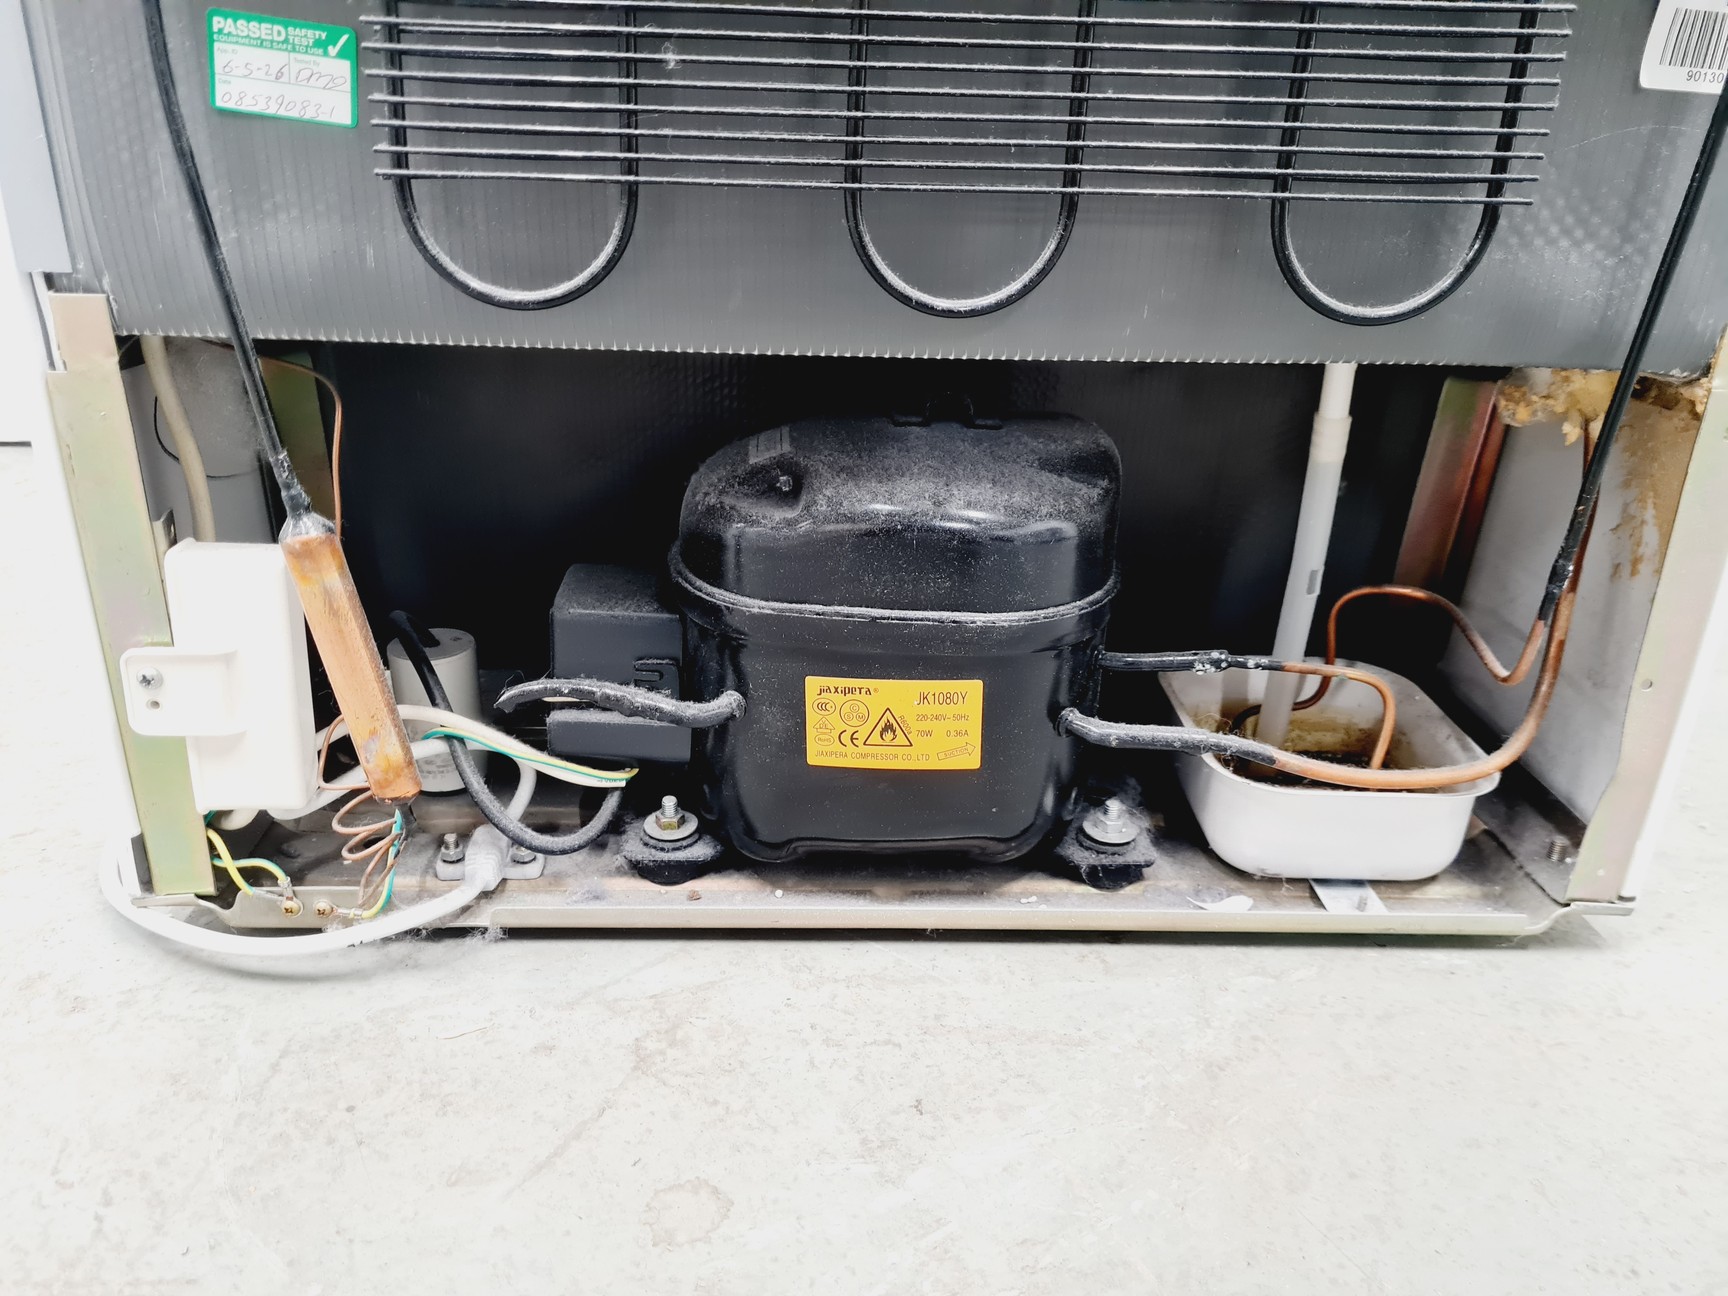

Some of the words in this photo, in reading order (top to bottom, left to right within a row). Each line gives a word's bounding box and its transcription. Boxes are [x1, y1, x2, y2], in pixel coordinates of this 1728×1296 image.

[212, 16, 286, 41] PASSED
[287, 26, 327, 40] SAFETY
[213, 34, 262, 47] EQUIPMENT
[263, 40, 272, 48] IS
[272, 41, 292, 51] SAFE
[296, 44, 306, 53] TO
[307, 46, 324, 56] USE
[287, 35, 315, 47] TEST
[1686, 69, 1725, 84] 90130
[916, 691, 969, 706] JK1080Y
[952, 713, 970, 722] 50Hz
[838, 729, 859, 748] CE
[916, 729, 933, 738] 70W
[946, 729, 969, 738] 0.36A
[815, 750, 848, 759] JIAXIPERA
[850, 751, 899, 761] COMPRESSOR
[943, 747, 969, 758] SUCTION
